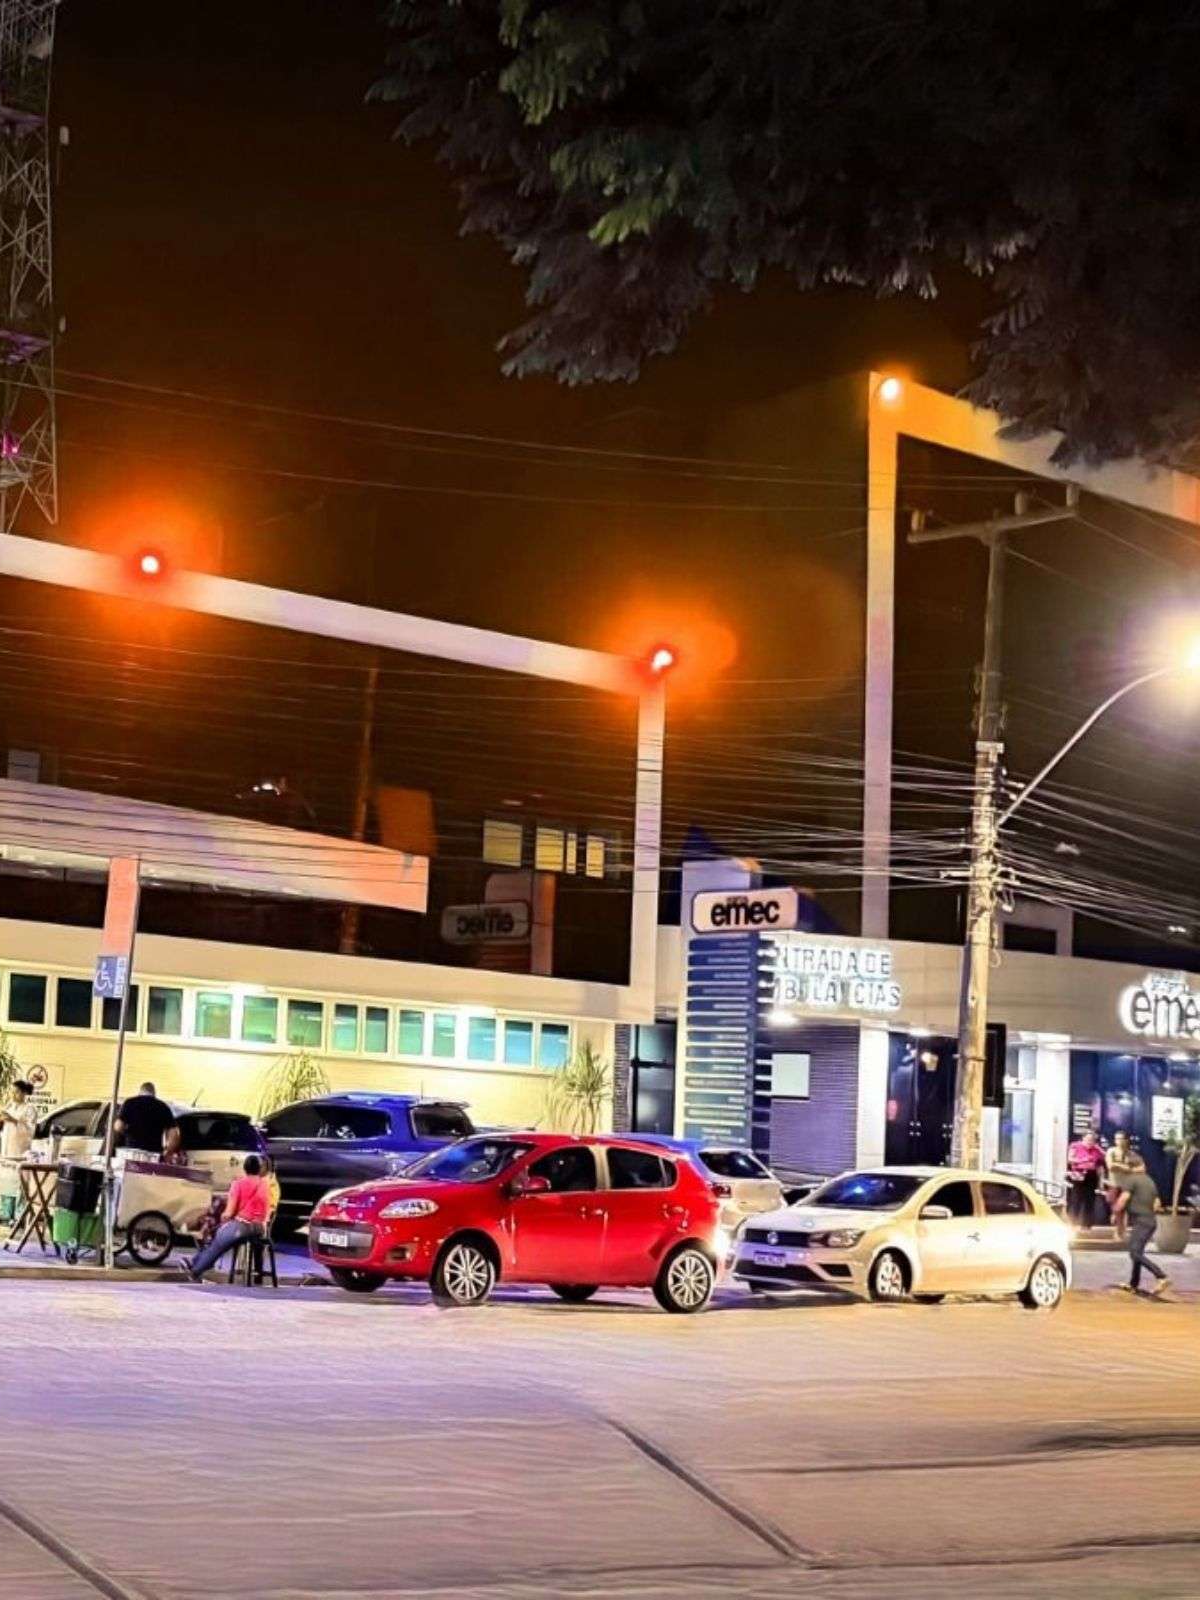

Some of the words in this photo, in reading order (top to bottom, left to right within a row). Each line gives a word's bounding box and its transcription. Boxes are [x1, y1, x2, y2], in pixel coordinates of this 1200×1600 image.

[710, 899, 780, 927] emec
[773, 946, 858, 974] NTRADA
[1129, 989, 1200, 1036] eme
